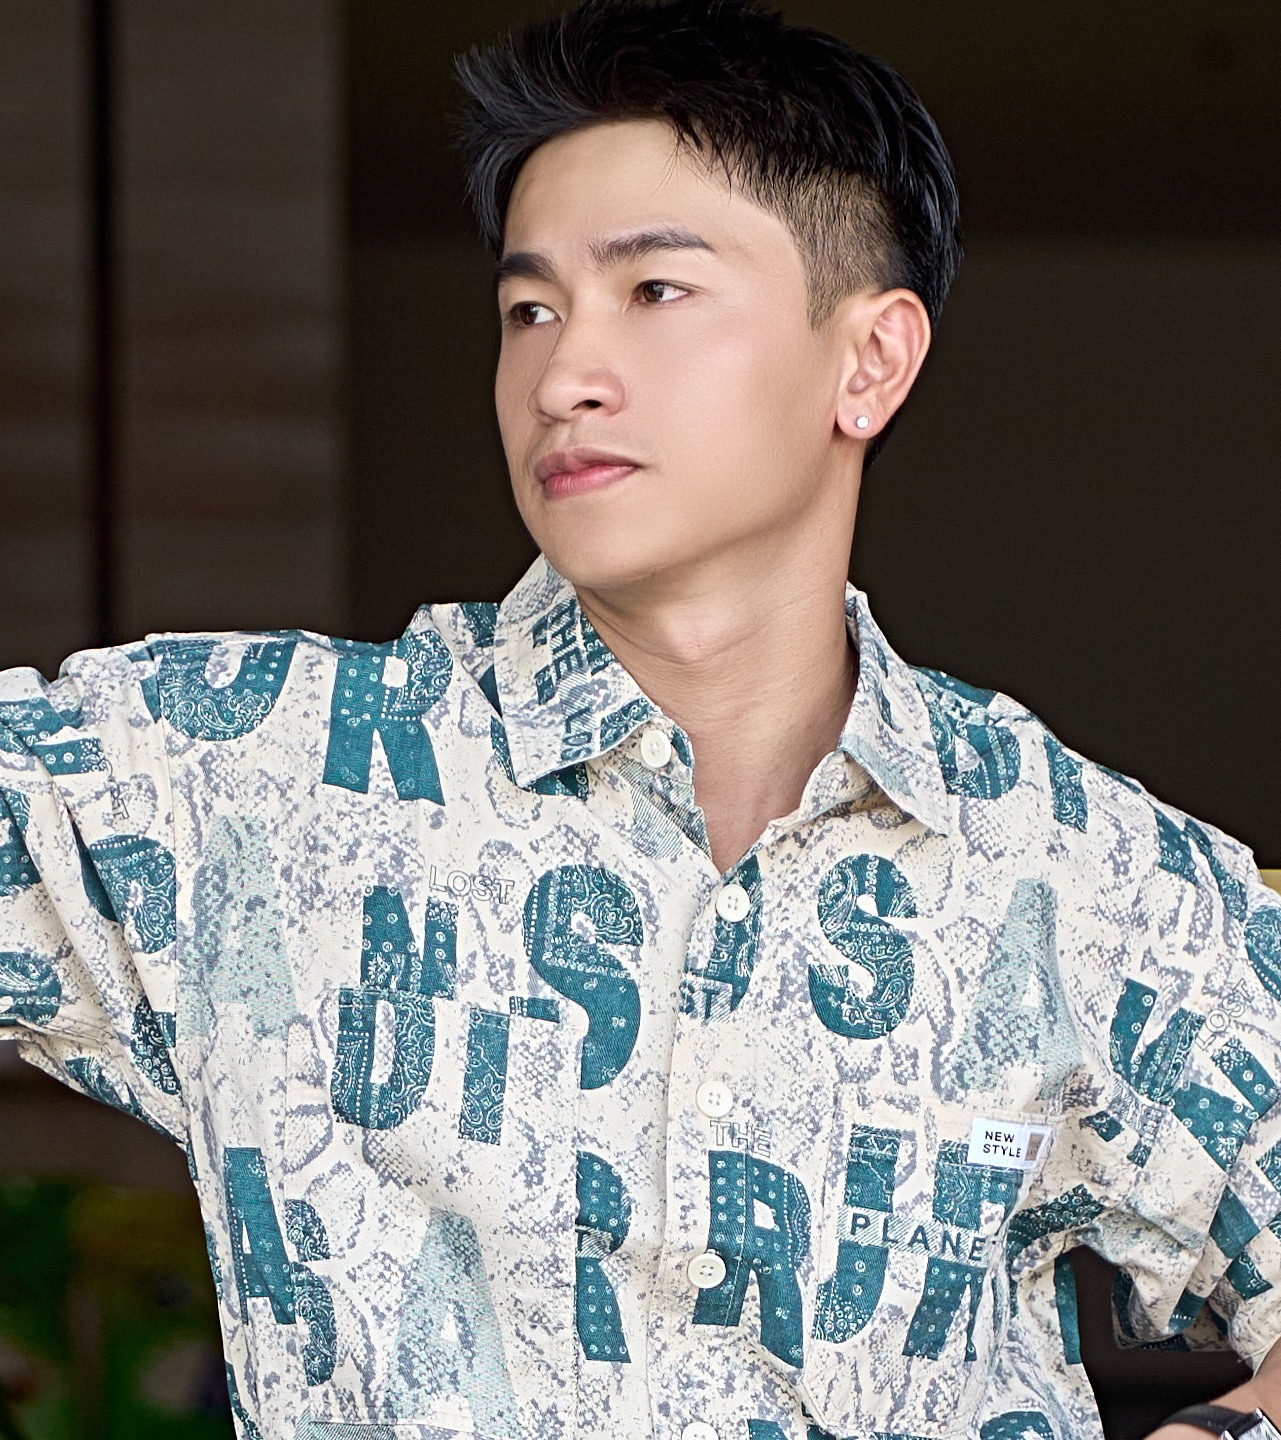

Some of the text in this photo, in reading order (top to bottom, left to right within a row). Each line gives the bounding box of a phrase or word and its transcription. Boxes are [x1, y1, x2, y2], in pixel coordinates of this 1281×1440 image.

[429, 864, 516, 905] LOST
[1195, 978, 1254, 1050] LOST
[710, 1120, 772, 1158] THE
[982, 1143, 1022, 1158] STYLE
[984, 1130, 1015, 1143] NEW
[850, 1212, 987, 1261] PLANE
